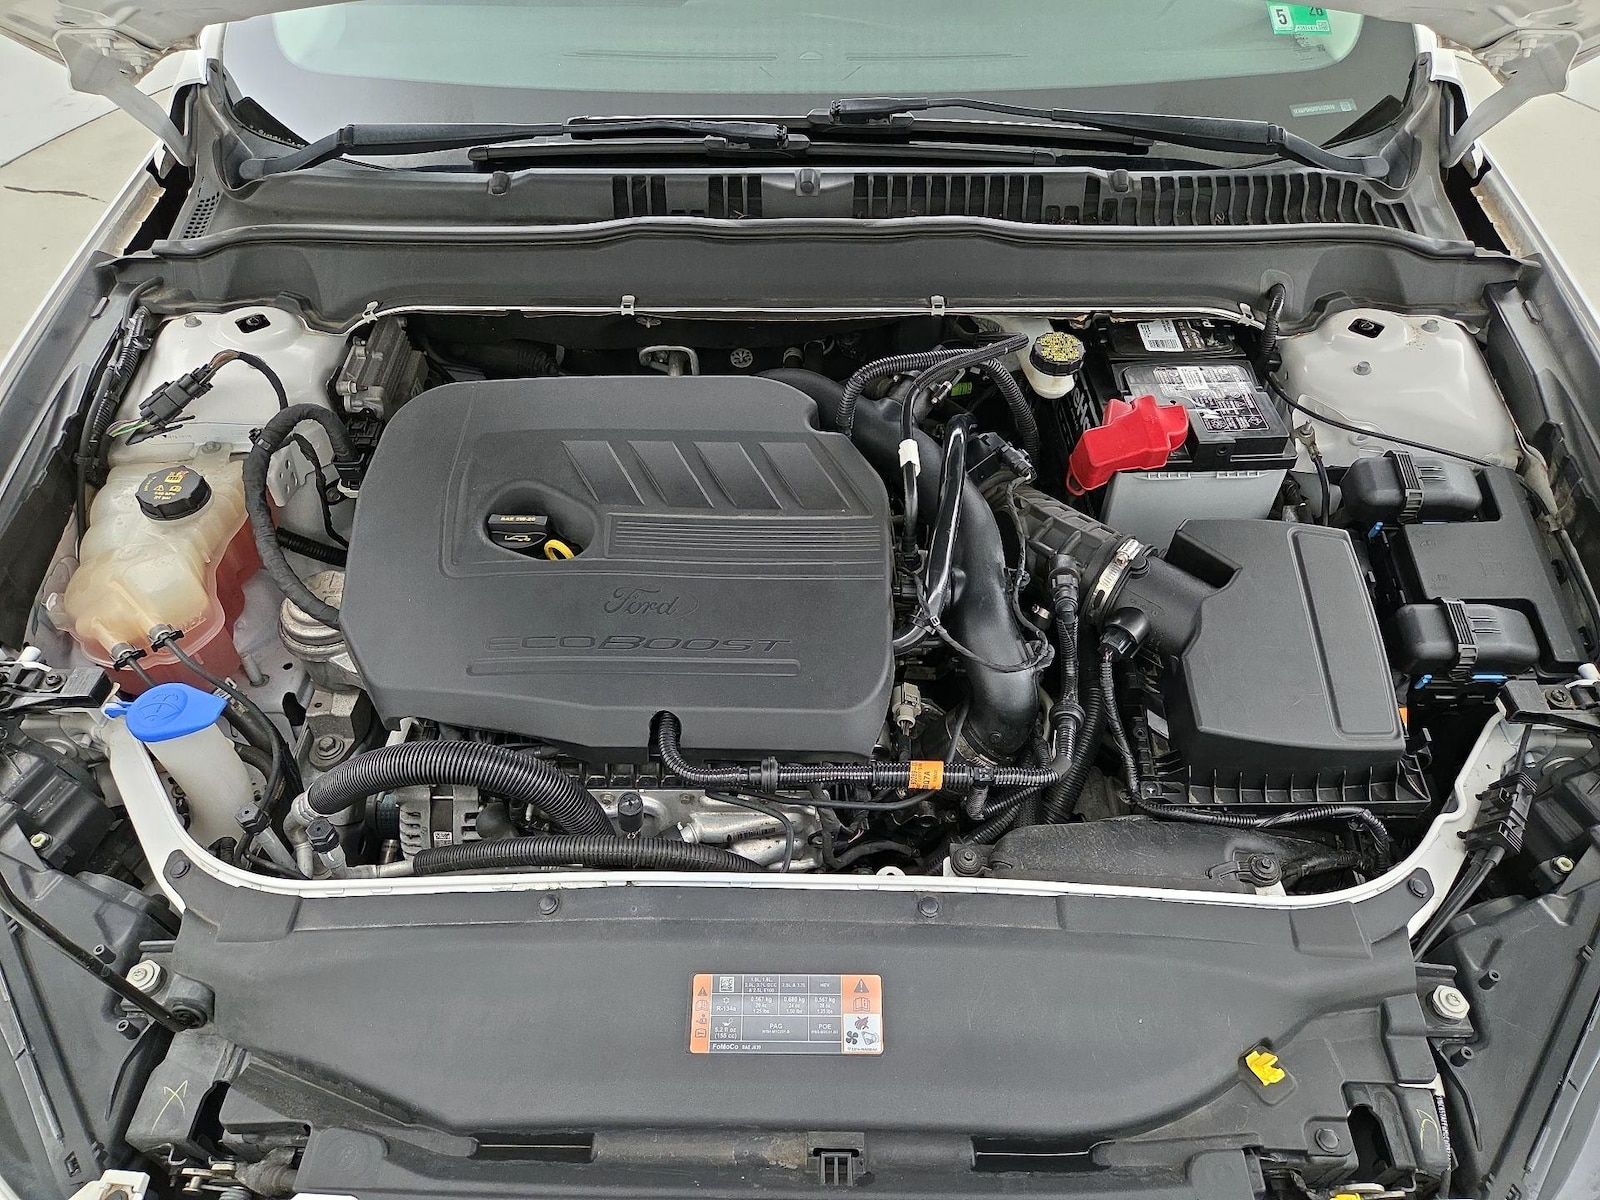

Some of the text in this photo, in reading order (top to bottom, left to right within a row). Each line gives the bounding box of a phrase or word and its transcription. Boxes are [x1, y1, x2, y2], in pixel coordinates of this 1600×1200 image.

[1276, 9, 1288, 24] 5
[603, 586, 681, 616] Ford
[484, 636, 792, 653] ECOBOOST
